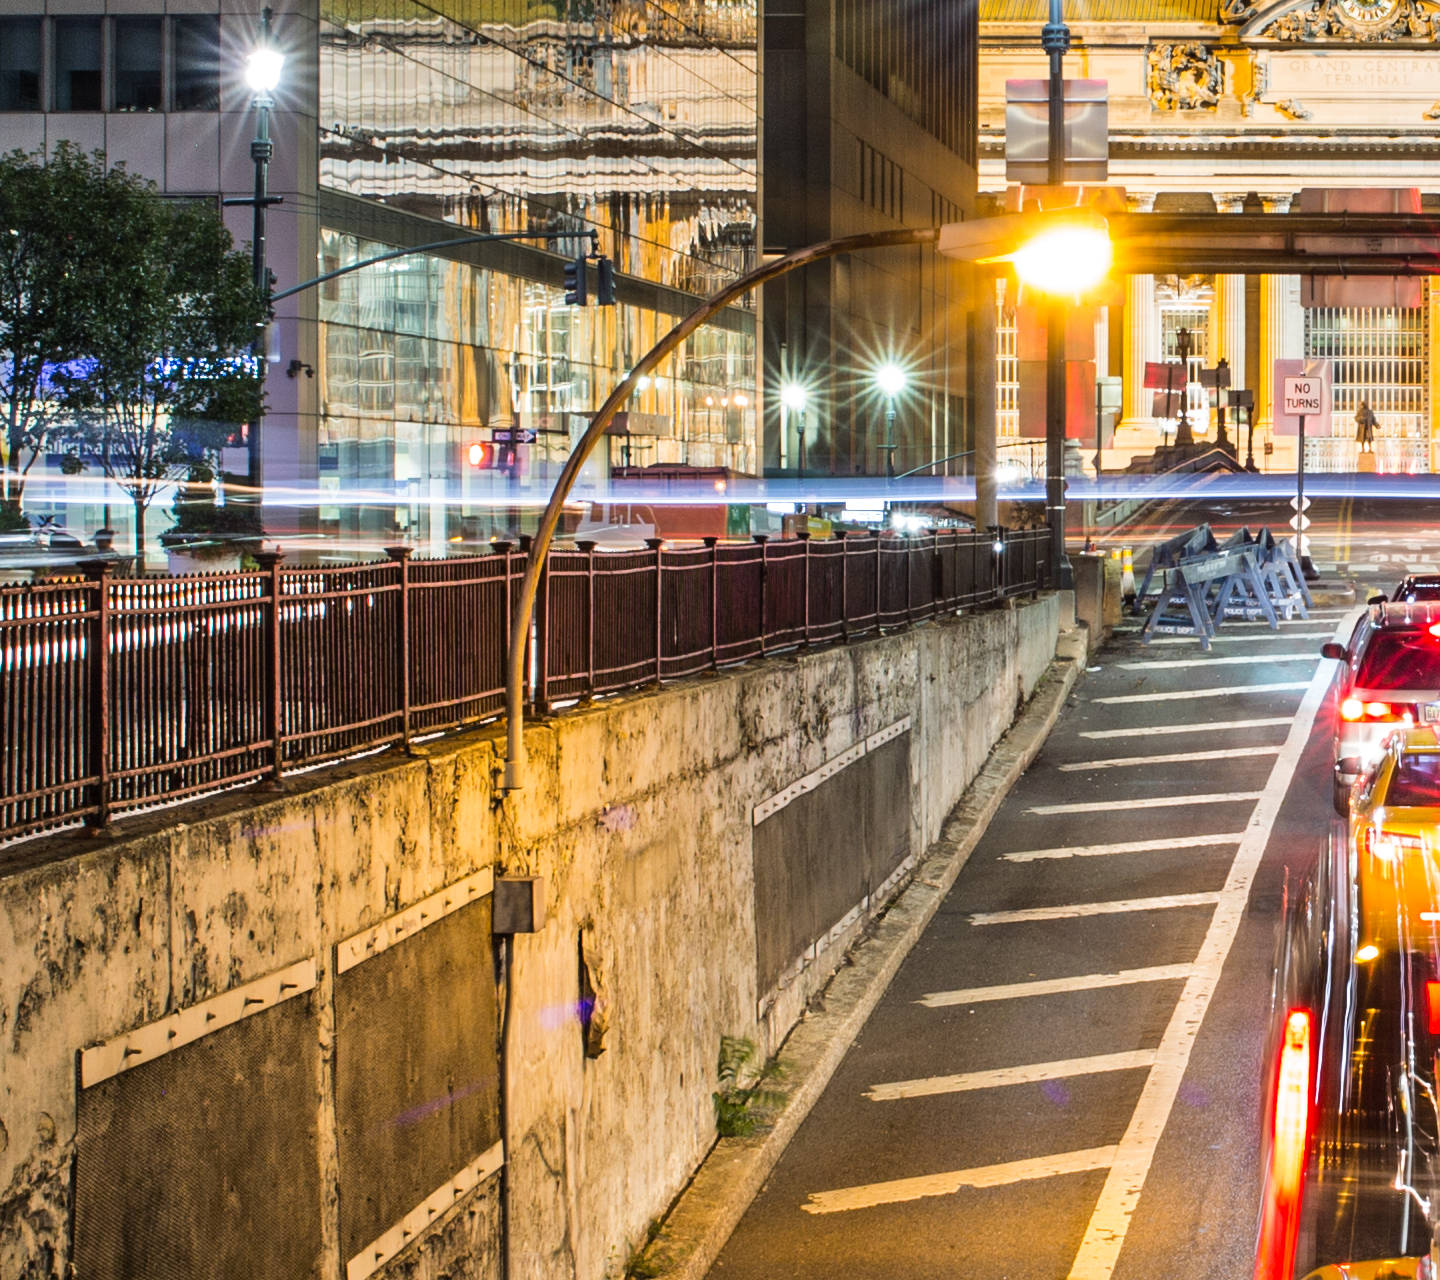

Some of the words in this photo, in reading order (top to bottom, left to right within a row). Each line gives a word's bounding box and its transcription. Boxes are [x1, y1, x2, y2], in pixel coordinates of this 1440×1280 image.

[1289, 61, 1351, 72] GRAND
[1324, 73, 1409, 86] TERMINAL
[1294, 383, 1310, 394] NO
[1286, 398, 1319, 408] TURNS
